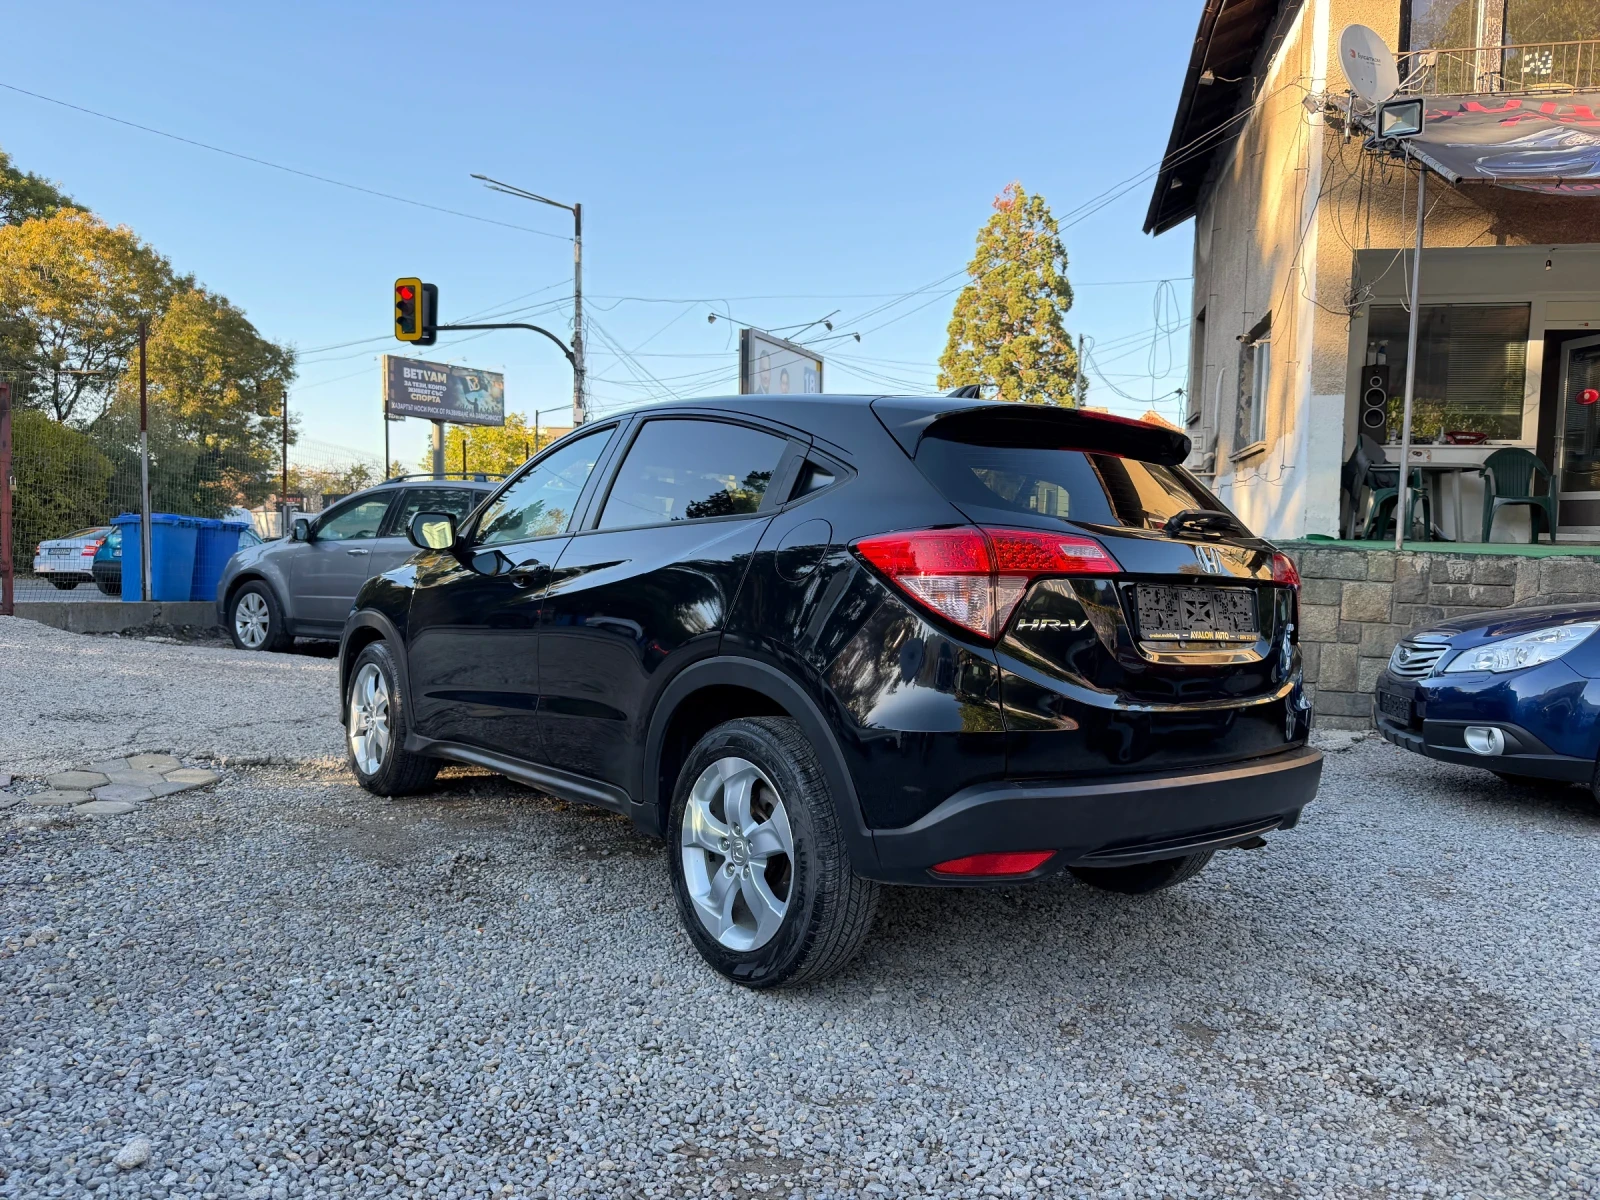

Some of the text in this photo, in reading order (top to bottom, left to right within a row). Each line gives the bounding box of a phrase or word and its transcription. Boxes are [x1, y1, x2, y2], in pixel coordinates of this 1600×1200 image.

[411, 393, 441, 403] СПОРТА
[427, 406, 440, 414] РИСК
[440, 407, 446, 415] ОТ
[1016, 618, 1090, 632] HR-V
[1190, 630, 1213, 639] AVALON
